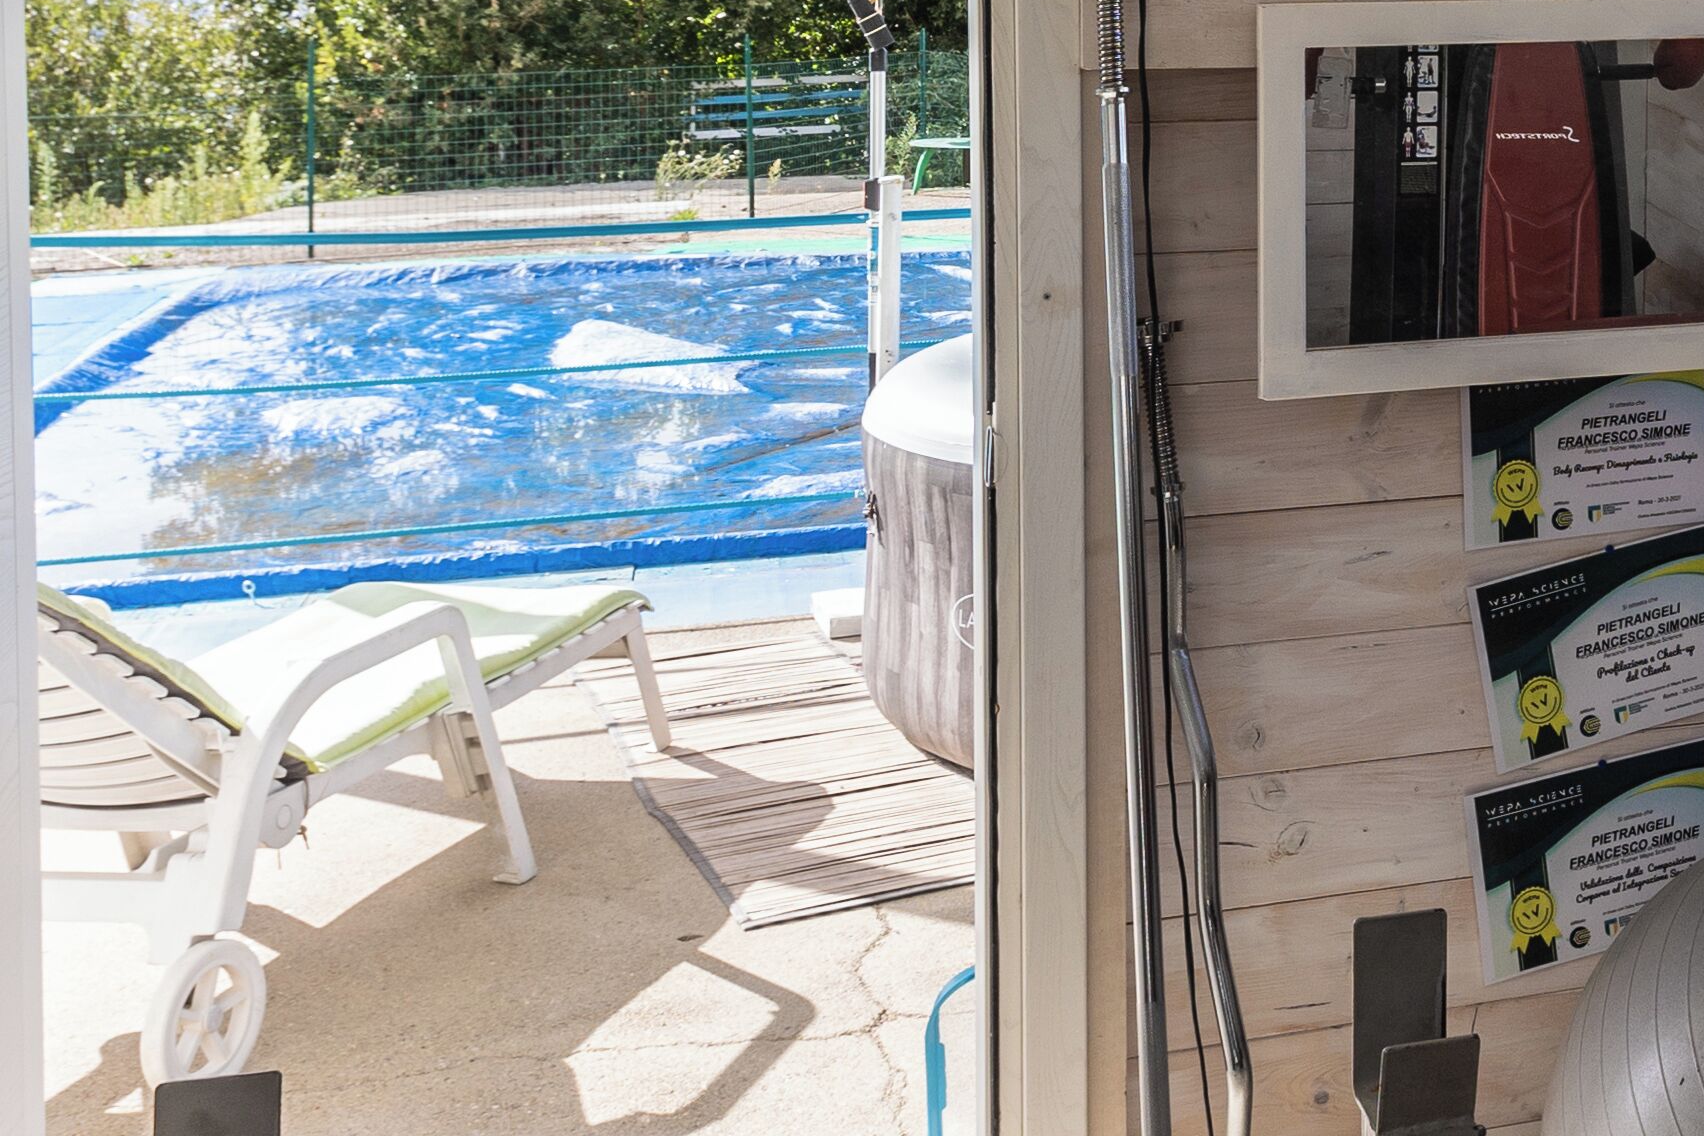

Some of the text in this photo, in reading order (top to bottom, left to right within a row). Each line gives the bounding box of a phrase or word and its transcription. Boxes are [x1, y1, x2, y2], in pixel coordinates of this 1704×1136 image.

[1557, 423, 1691, 449] FRANCESCO SIMONE
[1581, 410, 1667, 430] PIETRANGELI
[1553, 464, 1572, 477] Body
[1607, 455, 1657, 470] Dimagrimento
[1664, 451, 1698, 463] Fisiologia
[1489, 573, 1585, 607] WEPA SCIENCE
[1597, 603, 1681, 635] PIETRANGELI
[1576, 626, 1655, 658] FRANCESCO
[1597, 658, 1648, 678] Profilazione
[1657, 644, 1695, 660] Check-up
[1626, 663, 1671, 682] del Cliente
[1485, 784, 1583, 816] WEPA SCIENCE
[1570, 825, 1700, 870] FRANCESCO SIMONE
[1591, 816, 1675, 847] PIETRANGELI
[1576, 873, 1668, 905] Corporea ed Integrazione
[1580, 855, 1696, 891] Valutazione della Composizione
